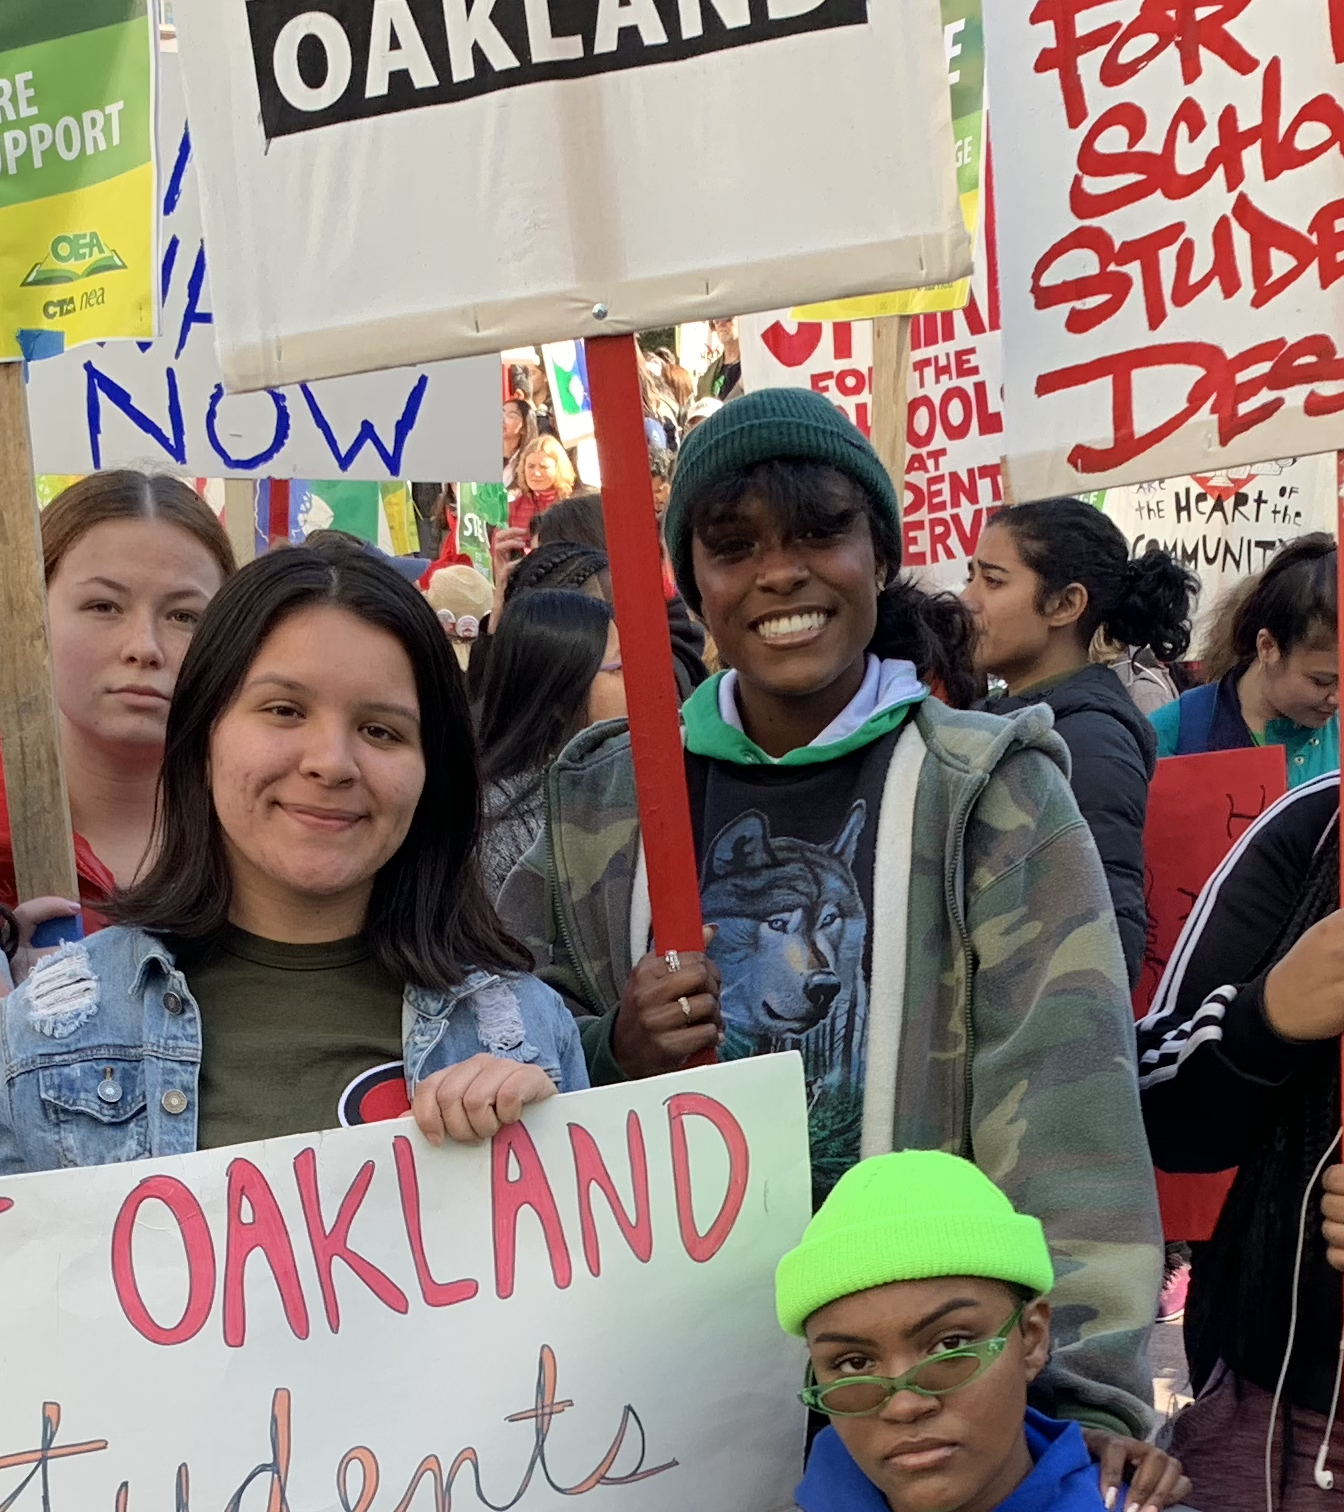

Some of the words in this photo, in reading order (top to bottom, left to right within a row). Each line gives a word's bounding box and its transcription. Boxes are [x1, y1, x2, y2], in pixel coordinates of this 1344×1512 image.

[1028, 0, 1260, 130] FOR
[50, 230, 106, 264] OEA
[43, 297, 76, 319] CTA
[79, 287, 105, 311] nea
[810, 366, 873, 397] FO
[912, 346, 980, 388] THE
[85, 361, 429, 477] NOW
[1278, 485, 1300, 500] OF
[1271, 503, 1303, 527] the
[112, 1091, 750, 1348] OAKLAND
